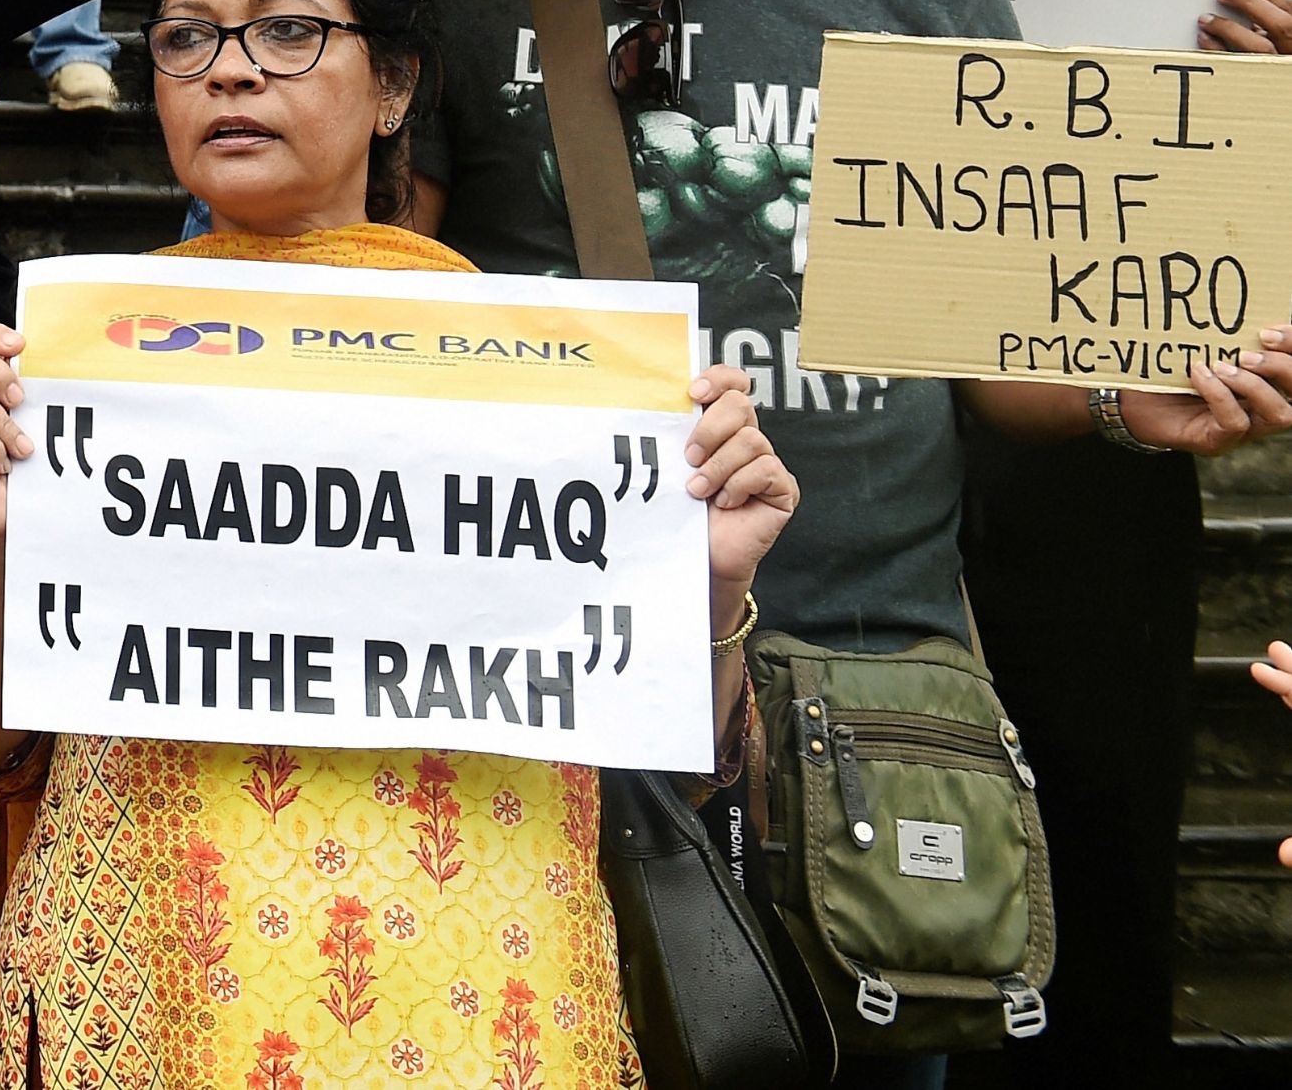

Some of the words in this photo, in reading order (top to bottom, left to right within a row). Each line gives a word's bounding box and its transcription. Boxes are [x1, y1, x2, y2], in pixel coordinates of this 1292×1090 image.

[1050, 252, 1248, 336] KARO
[292, 328, 416, 351] PMC
[439, 335, 595, 362] BANK
[728, 806, 743, 858] WORLD
[909, 853, 954, 867] cropp
